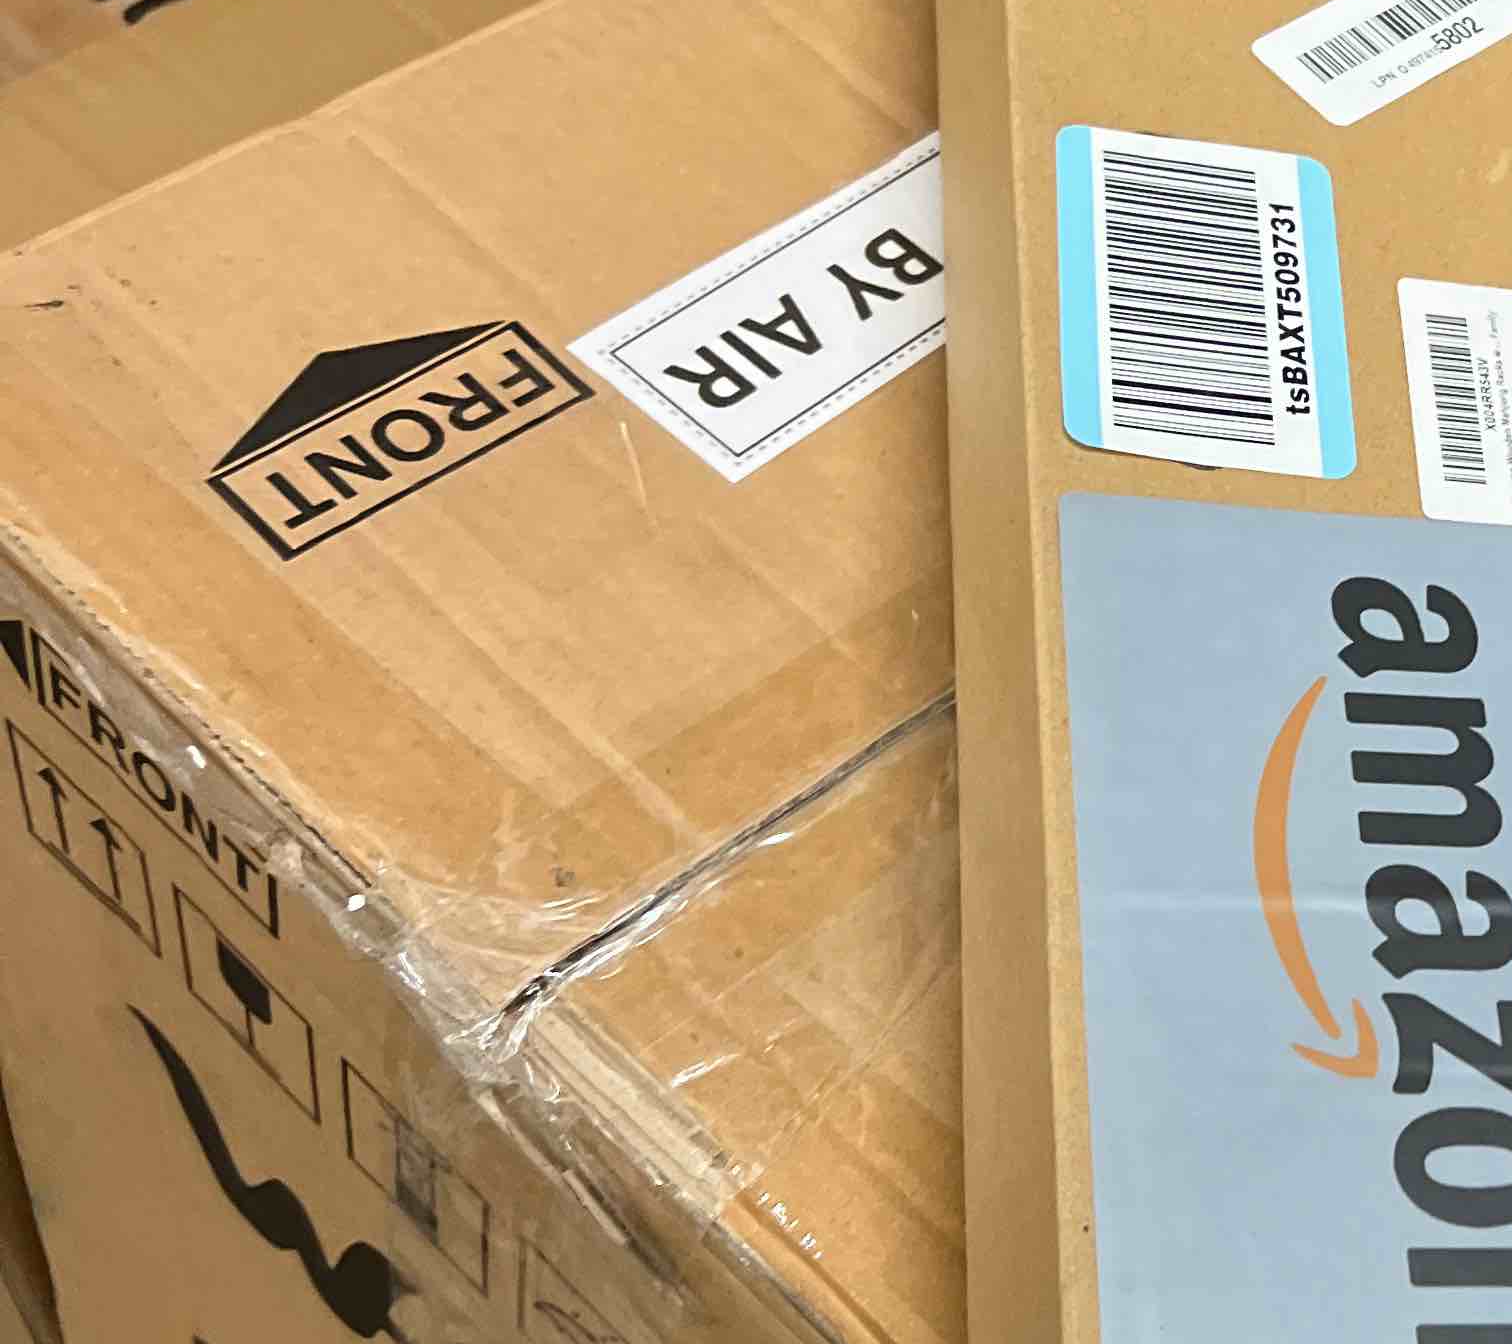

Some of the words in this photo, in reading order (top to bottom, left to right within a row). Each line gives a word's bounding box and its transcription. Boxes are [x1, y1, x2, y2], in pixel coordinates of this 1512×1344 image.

[1430, 16, 1484, 50] 5802
[827, 226, 945, 323] BY
[1270, 202, 1312, 416] tsBAXT509731
[662, 293, 826, 410] AIR
[264, 347, 557, 530] FRONT
[49, 659, 260, 892] FRONT
